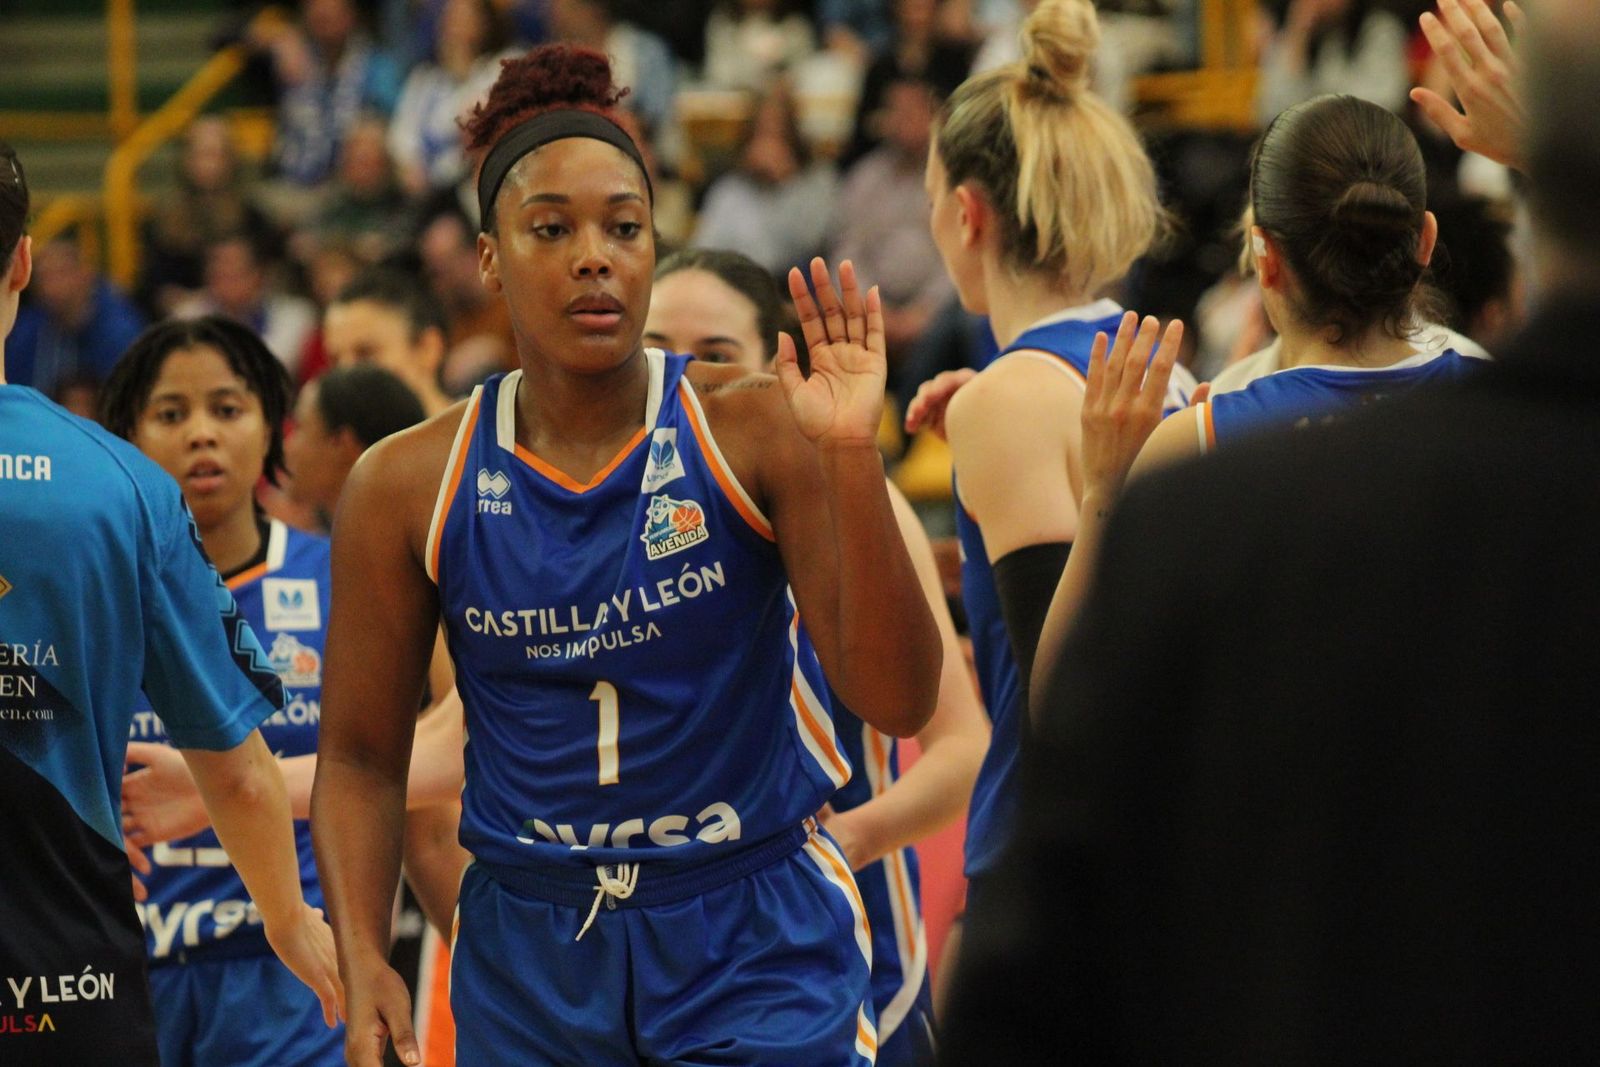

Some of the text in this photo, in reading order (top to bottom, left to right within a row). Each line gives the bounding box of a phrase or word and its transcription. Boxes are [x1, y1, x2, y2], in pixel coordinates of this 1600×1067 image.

[650, 526, 707, 557] AVENIDA
[465, 561, 726, 637] CASTILLA Y LEÓN
[526, 622, 662, 659] NOS IMPULSA
[0, 674, 36, 698] EN
[588, 680, 619, 785] 1
[7, 964, 114, 1009] Y LEÓN
